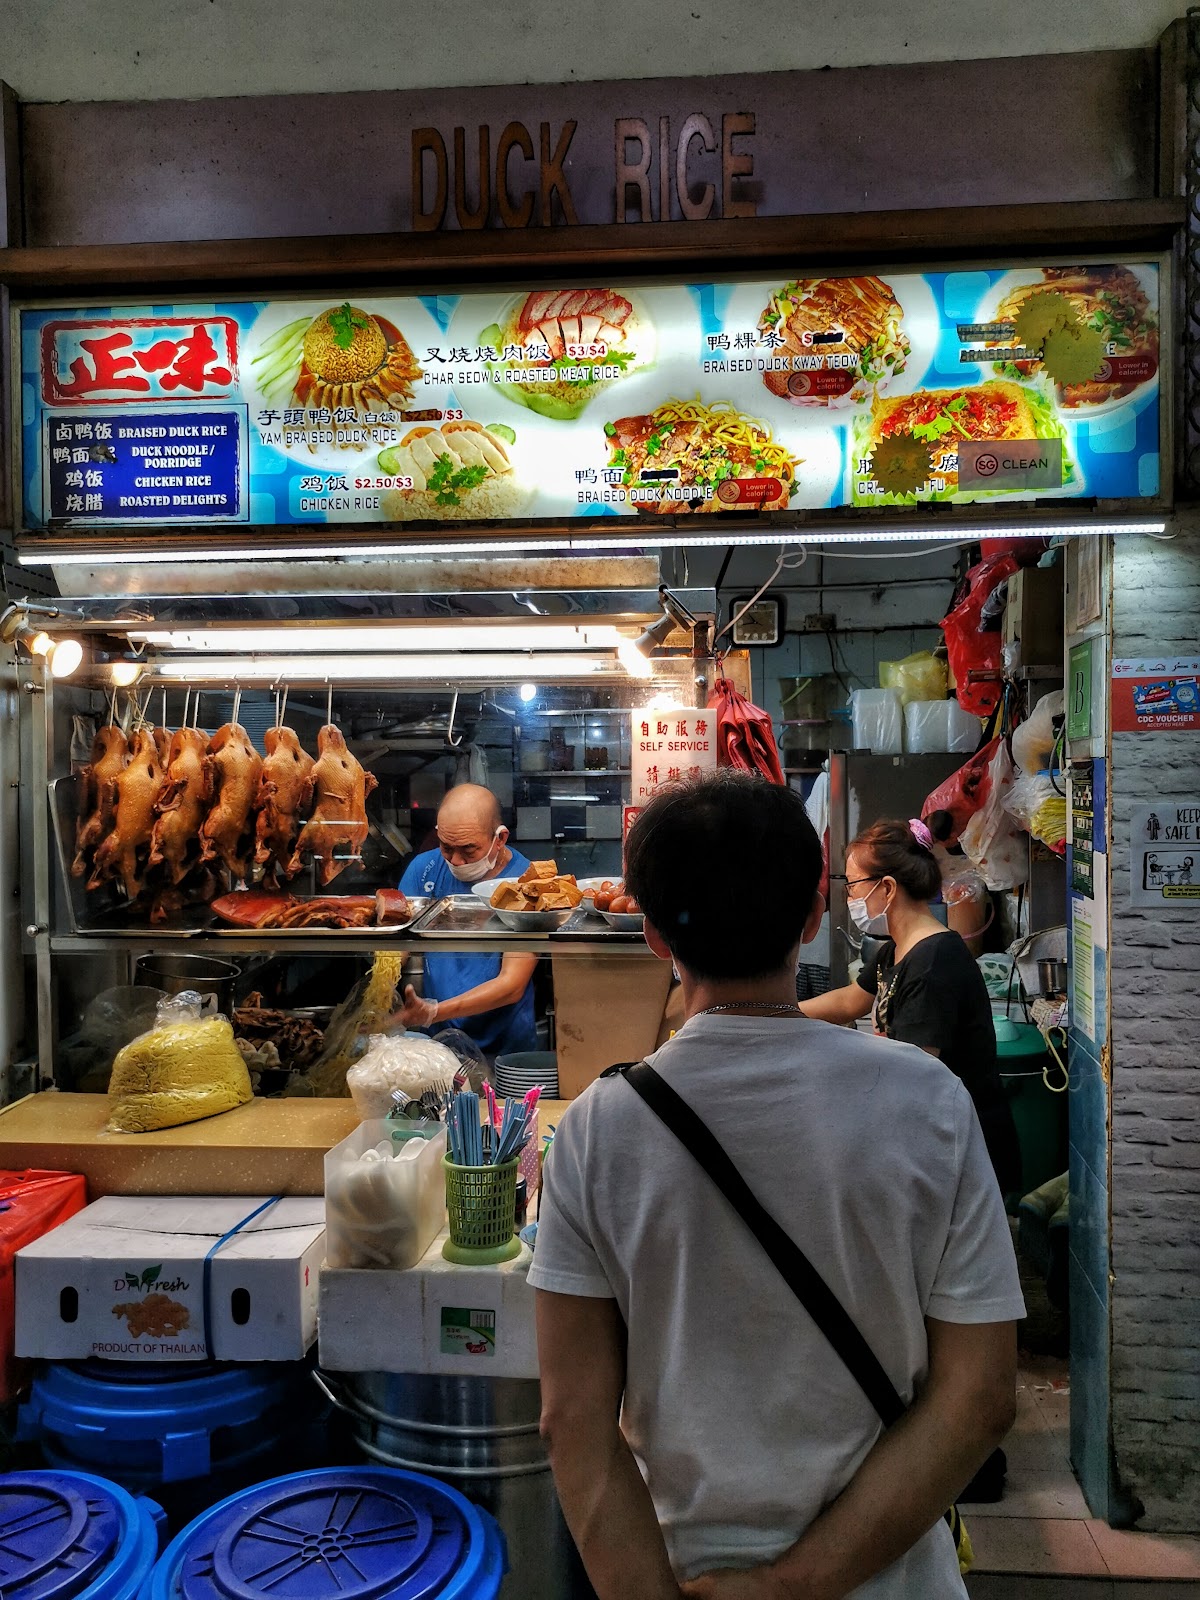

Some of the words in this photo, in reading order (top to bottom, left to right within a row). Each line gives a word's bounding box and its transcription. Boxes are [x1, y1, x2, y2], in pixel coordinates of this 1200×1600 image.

[411, 120, 579, 232] DUCK
[614, 111, 756, 224] RICE
[706, 331, 786, 351] 鸭粿条
[568, 344, 607, 358] $3/$4
[57, 324, 234, 398] 正味
[703, 359, 753, 373] BRAISED
[757, 358, 789, 371] DUCK
[793, 356, 826, 370] KWAY
[828, 354, 860, 368] TEOW
[1118, 362, 1140, 370] Lower
[424, 372, 454, 385] CHAR
[493, 371, 501, 383] &
[506, 369, 557, 382] ROASTED
[561, 367, 589, 381] MEAT
[594, 366, 620, 379] RICE
[1118, 368, 1149, 376] calories
[816, 376, 837, 384] Lower
[816, 382, 846, 391] calories
[56, 421, 113, 441] 卤鸭饭
[118, 427, 167, 438] BRAISED
[169, 426, 200, 437] DUCK
[201, 425, 228, 436] RICE
[260, 432, 283, 445] YAM
[286, 431, 334, 444] BRAISED
[337, 430, 368, 443] DUCK
[372, 429, 397, 442] RICE
[132, 446, 162, 457] DUCK
[144, 457, 202, 468] PORRIDGE
[978, 458, 995, 471] SG
[1002, 458, 1049, 470] CLEAN
[65, 469, 104, 488] 鸡饭
[134, 476, 183, 487] CHICKEN
[185, 475, 212, 486] RICE
[300, 475, 350, 492] 鸡饭
[354, 477, 413, 490] $2.50/$3
[575, 468, 625, 484] 鸭面
[745, 483, 767, 491] Lower
[768, 482, 775, 490] in
[745, 489, 775, 498] calories
[65, 493, 104, 511] 烧腊
[119, 496, 170, 507] ROASTED
[172, 494, 228, 506] DELIGHTS
[577, 489, 627, 503] BRAISED
[630, 489, 662, 502] DUCK
[666, 486, 713, 501] NOODLE
[301, 497, 351, 511] CHICKEN
[355, 496, 380, 509] RICE
[1075, 671, 1084, 714] B
[1156, 714, 1195, 723] VOUCHER
[640, 719, 708, 737] 自助服務
[640, 741, 664, 752] SELF
[667, 741, 709, 752] SERVICE
[1176, 808, 1200, 824] KEEP
[1165, 825, 1192, 840] SAFE
[92, 1342, 141, 1354] PRODUCT
[143, 1343, 156, 1353] OF
[159, 1343, 206, 1354] THAILAN
